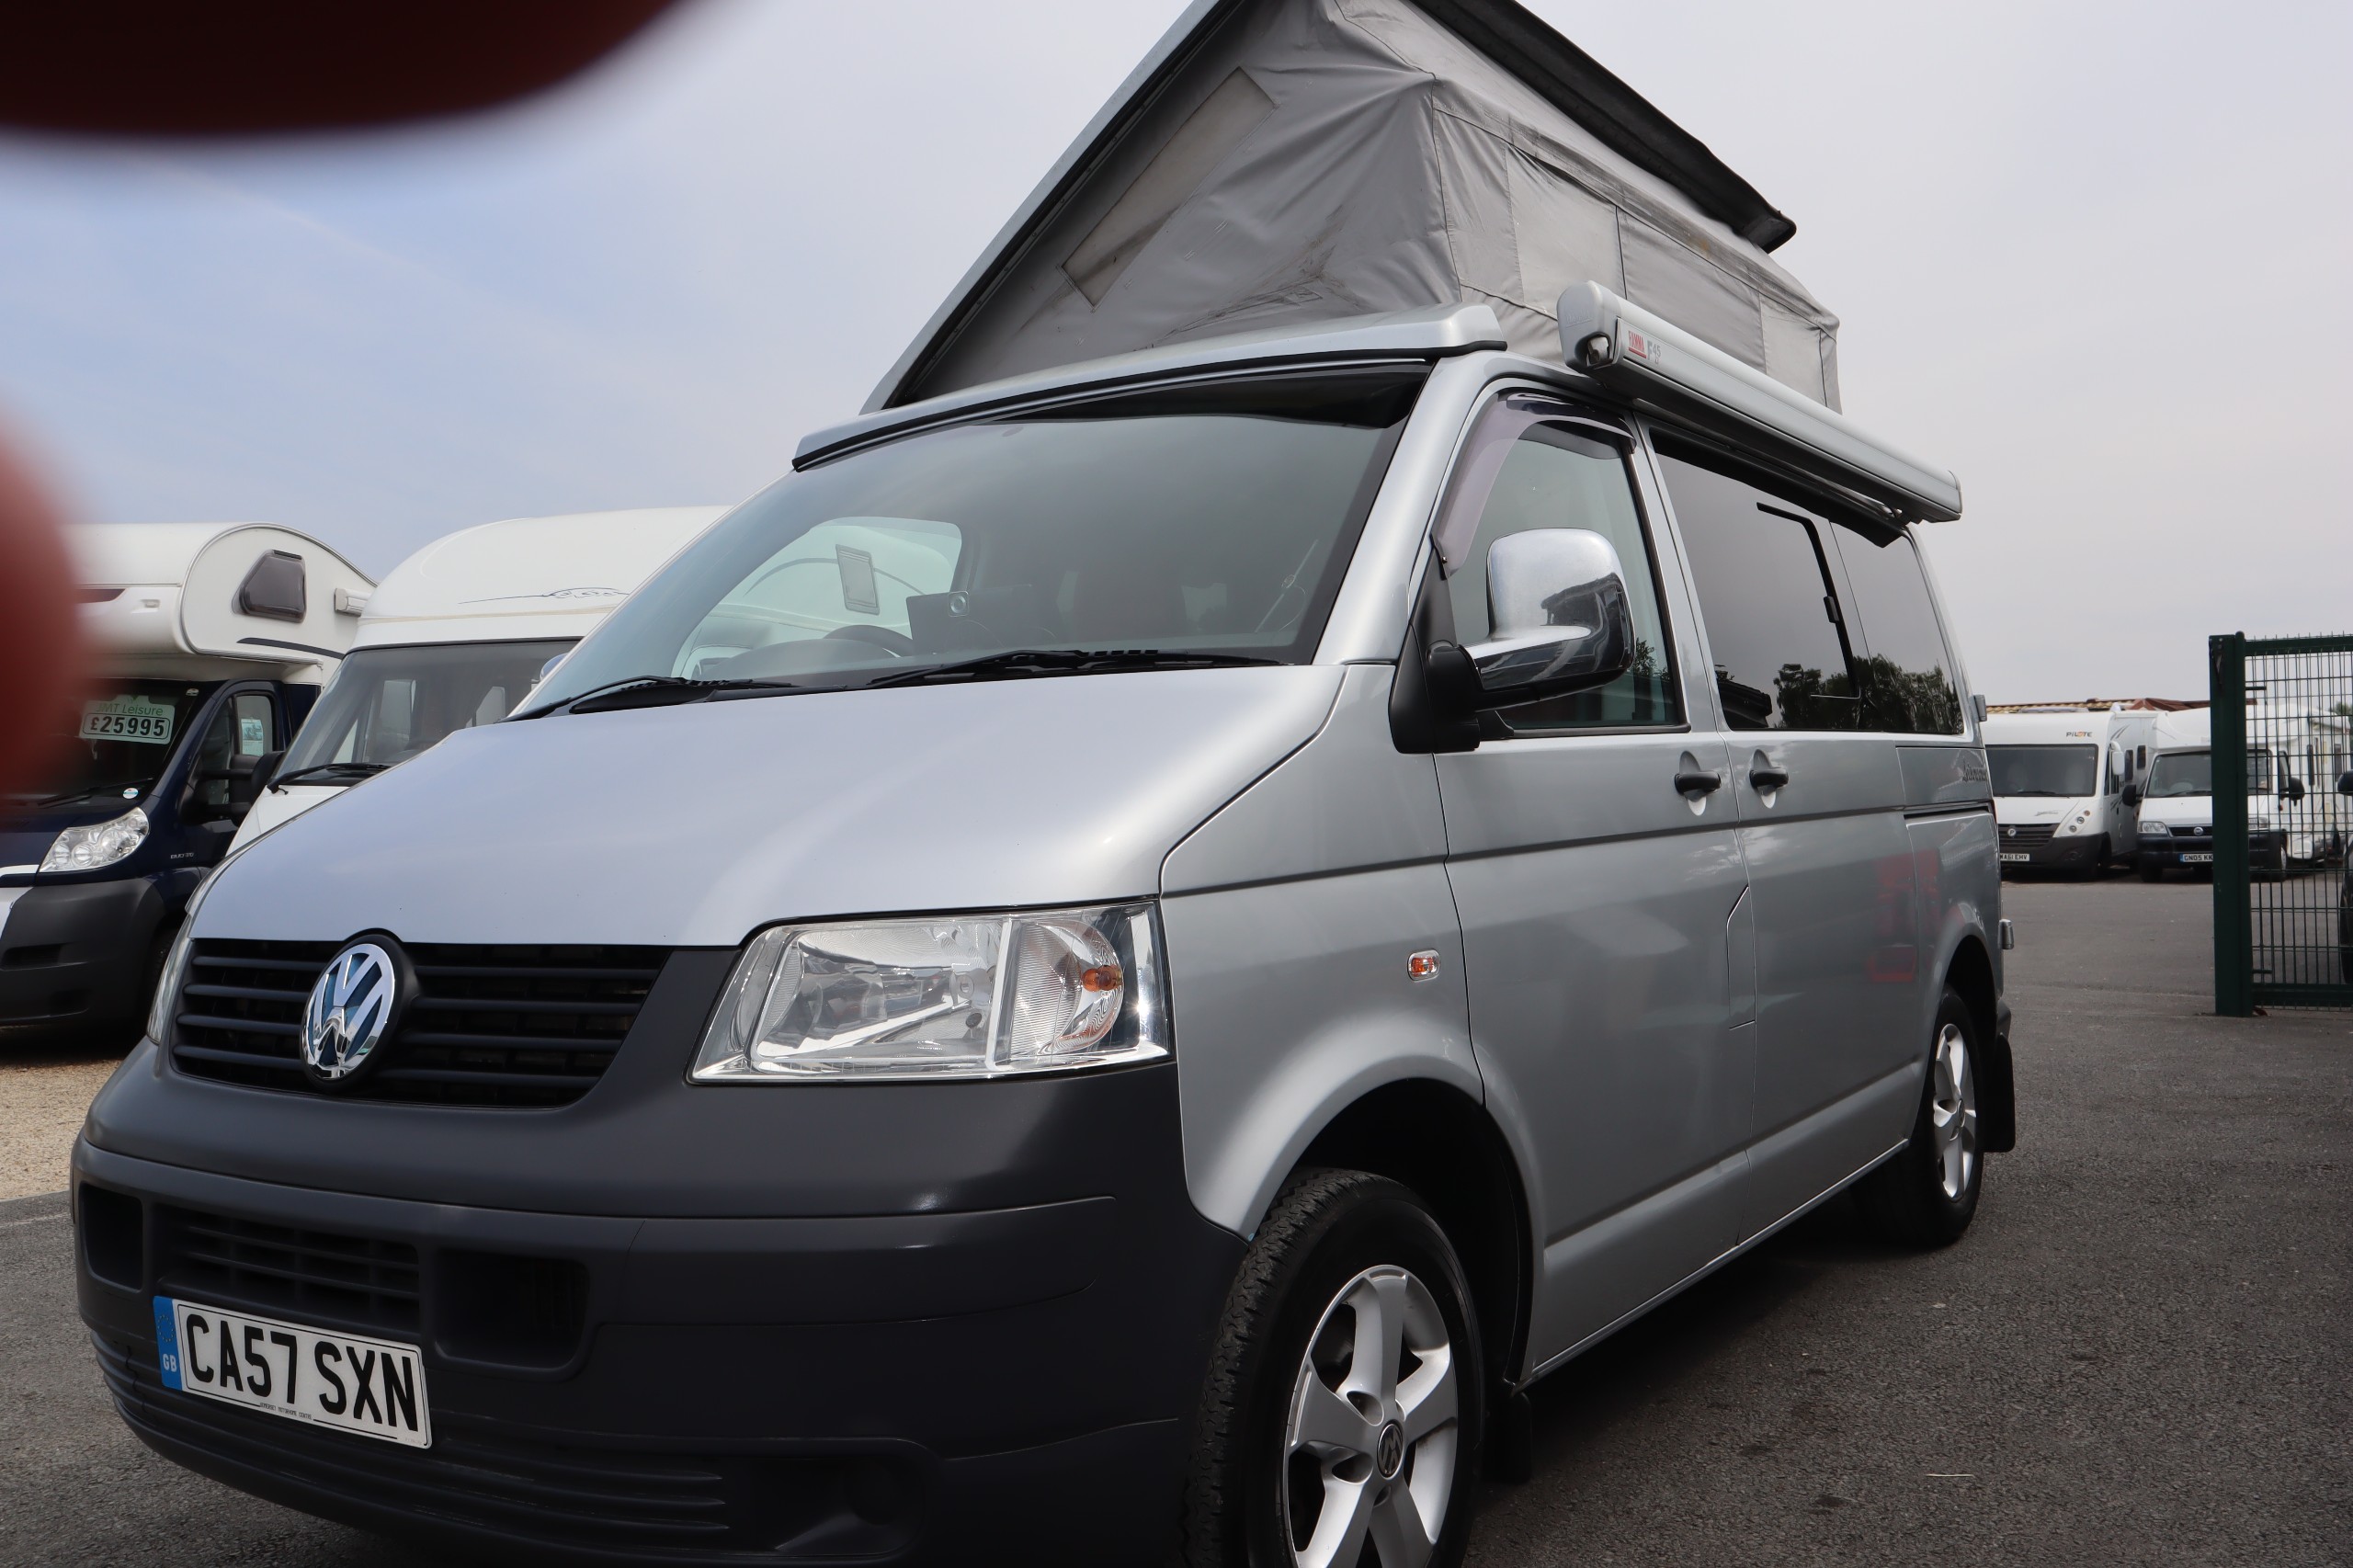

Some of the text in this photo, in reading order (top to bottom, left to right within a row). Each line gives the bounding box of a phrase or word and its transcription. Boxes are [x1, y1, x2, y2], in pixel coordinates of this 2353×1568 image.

[122, 703, 164, 717] Leisure
[90, 716, 165, 737] £25995
[163, 1353, 177, 1373] GB
[186, 1314, 419, 1432] CA57 SXN
